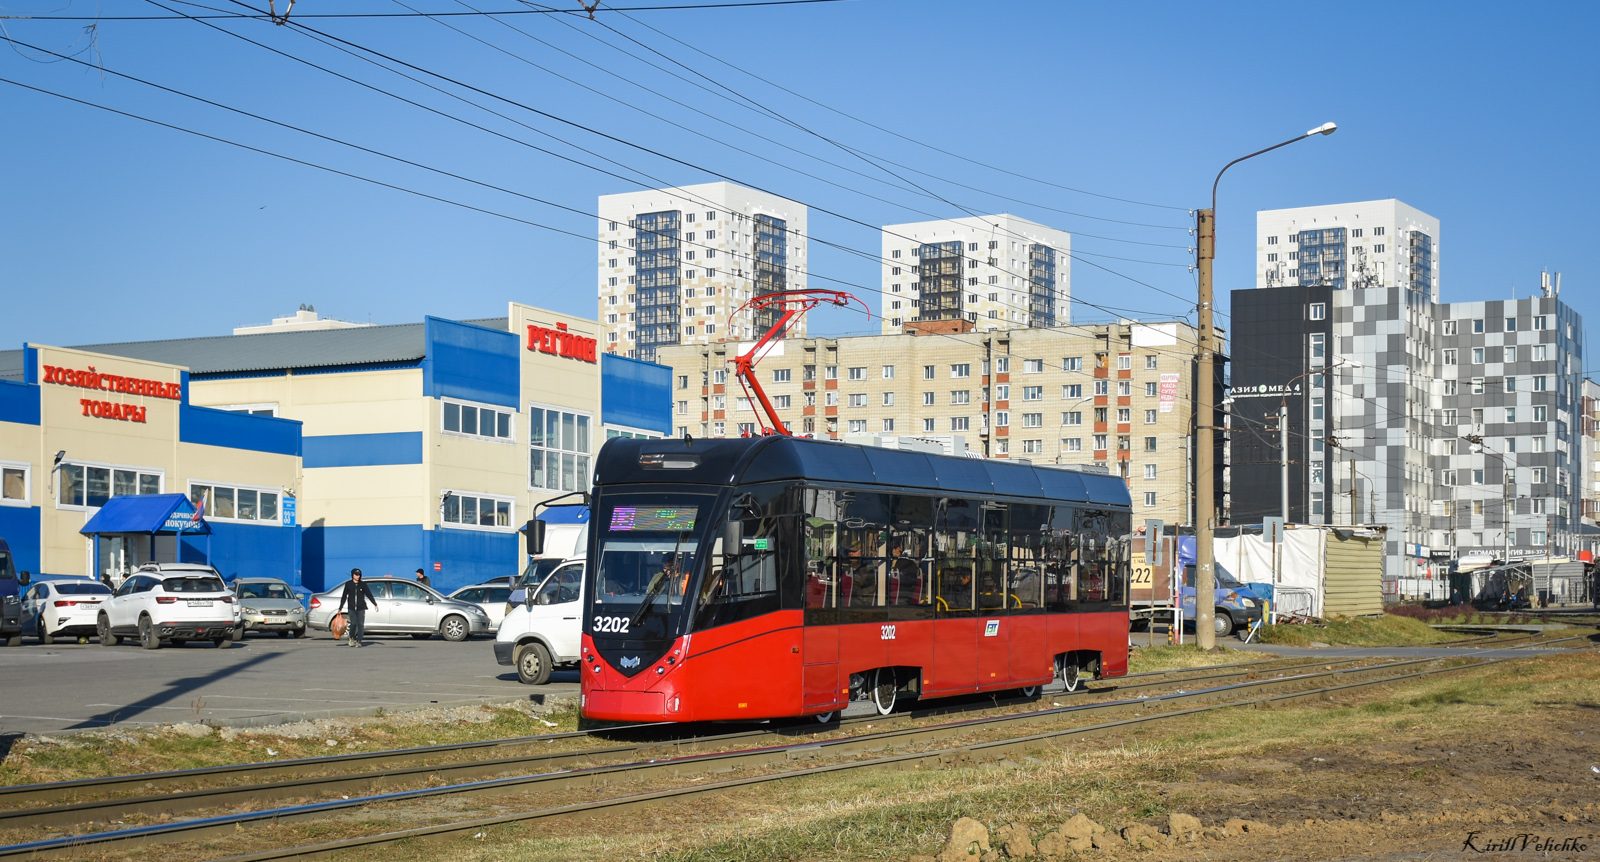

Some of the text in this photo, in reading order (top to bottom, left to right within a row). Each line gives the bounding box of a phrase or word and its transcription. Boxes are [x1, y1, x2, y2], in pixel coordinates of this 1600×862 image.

[527, 325, 597, 363] РЕГИОН
[43, 365, 181, 399] ХОЗЯЙСТВЕННЫЕ
[1230, 384, 1300, 394] АЗИЯ МЕД 4
[80, 399, 146, 423] ТОВАРЫ
[593, 616, 630, 633] 3202
[881, 625, 896, 640] 3202
